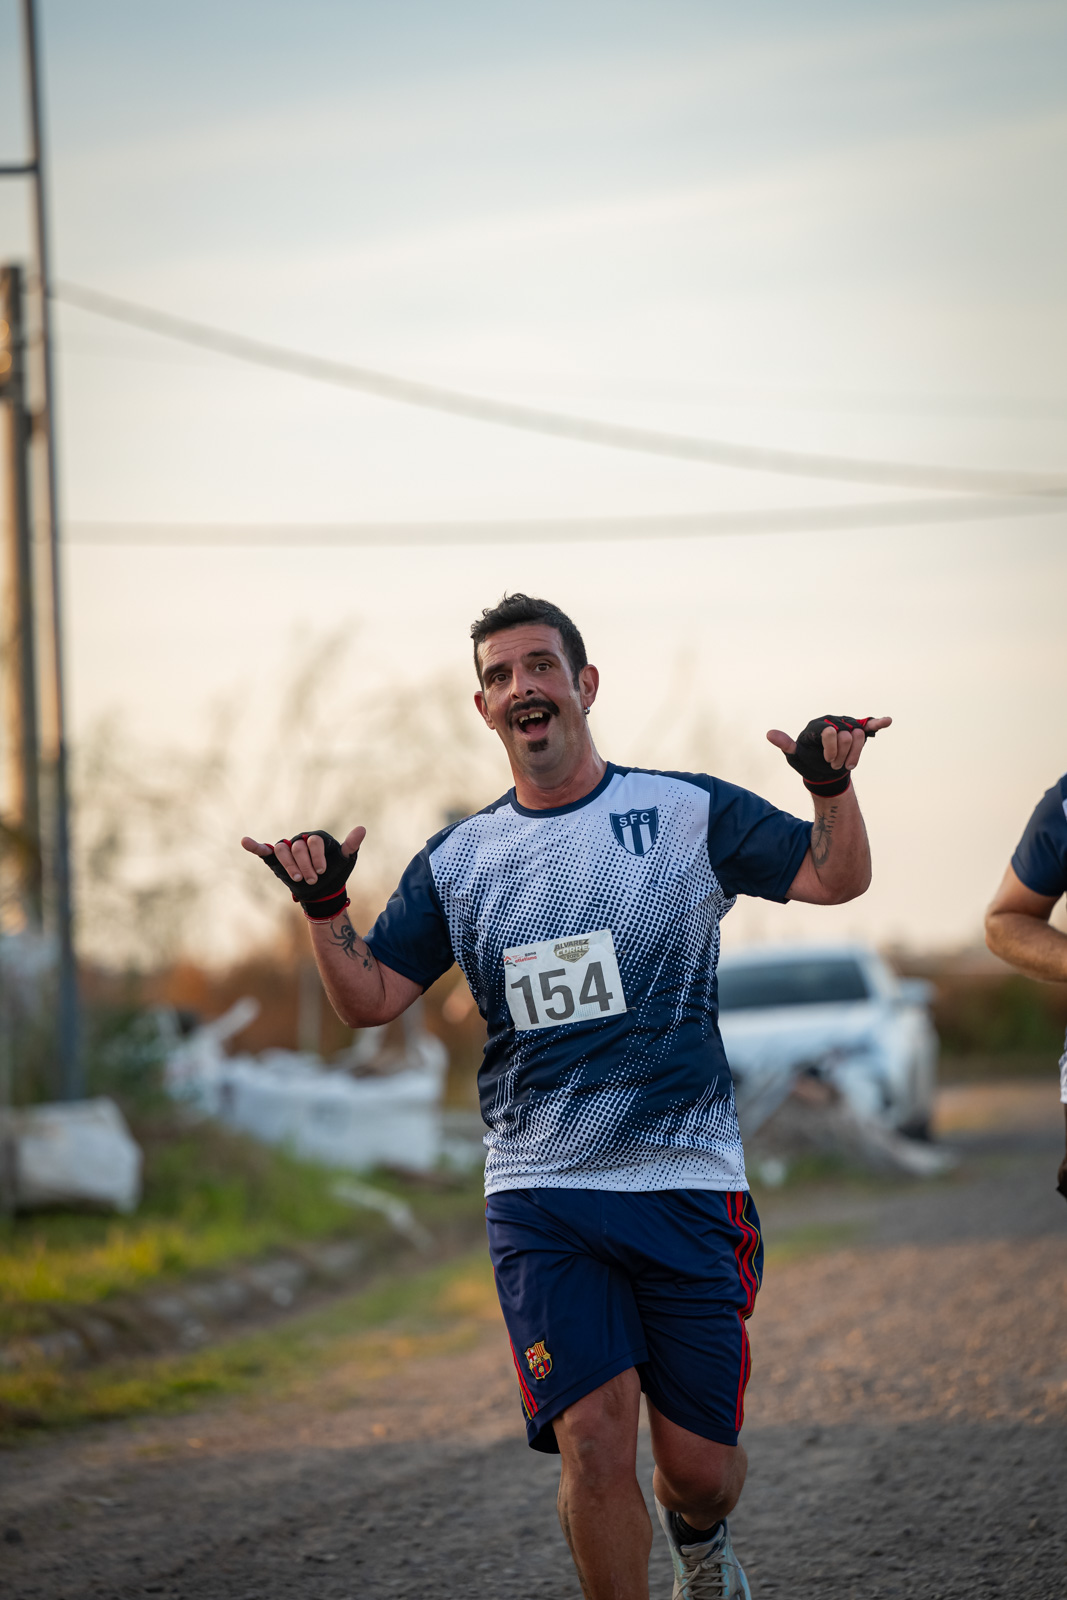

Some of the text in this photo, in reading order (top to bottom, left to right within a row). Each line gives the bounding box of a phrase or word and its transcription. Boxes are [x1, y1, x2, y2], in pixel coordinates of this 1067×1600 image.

[619, 812, 650, 827] SFC
[554, 939, 589, 951] ALVAREZ
[556, 944, 589, 957] CORRE
[510, 961, 614, 1025] 154
